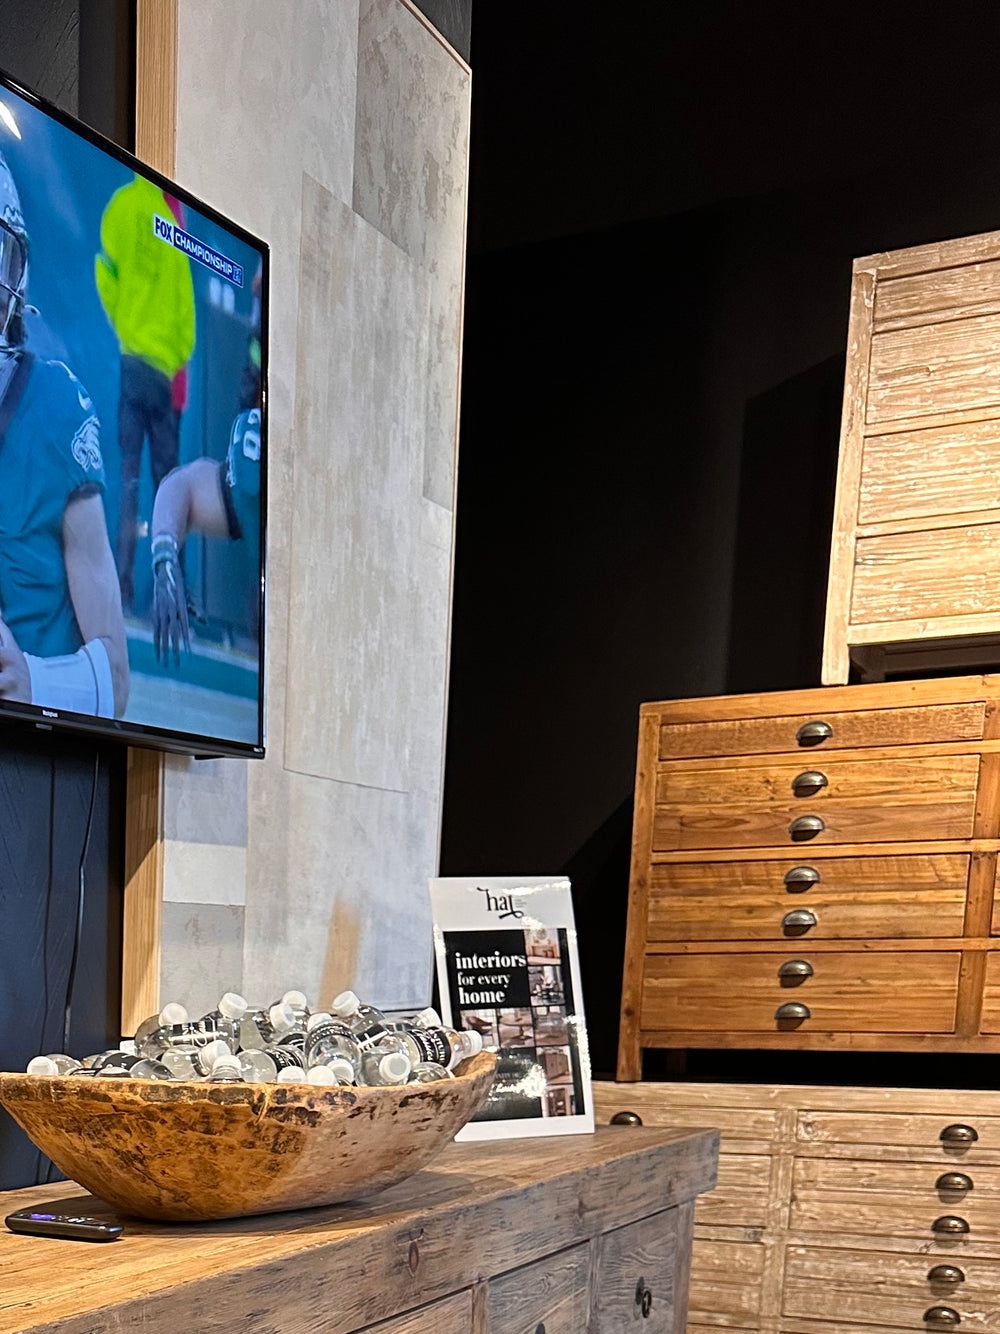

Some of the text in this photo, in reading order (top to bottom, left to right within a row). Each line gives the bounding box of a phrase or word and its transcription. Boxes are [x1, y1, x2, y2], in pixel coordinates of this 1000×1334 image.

[155, 216, 233, 276] FOX CHAMPIONSHIP
[455, 950, 527, 969] interiors
[457, 972, 511, 988] for every
[458, 987, 506, 1005] home
